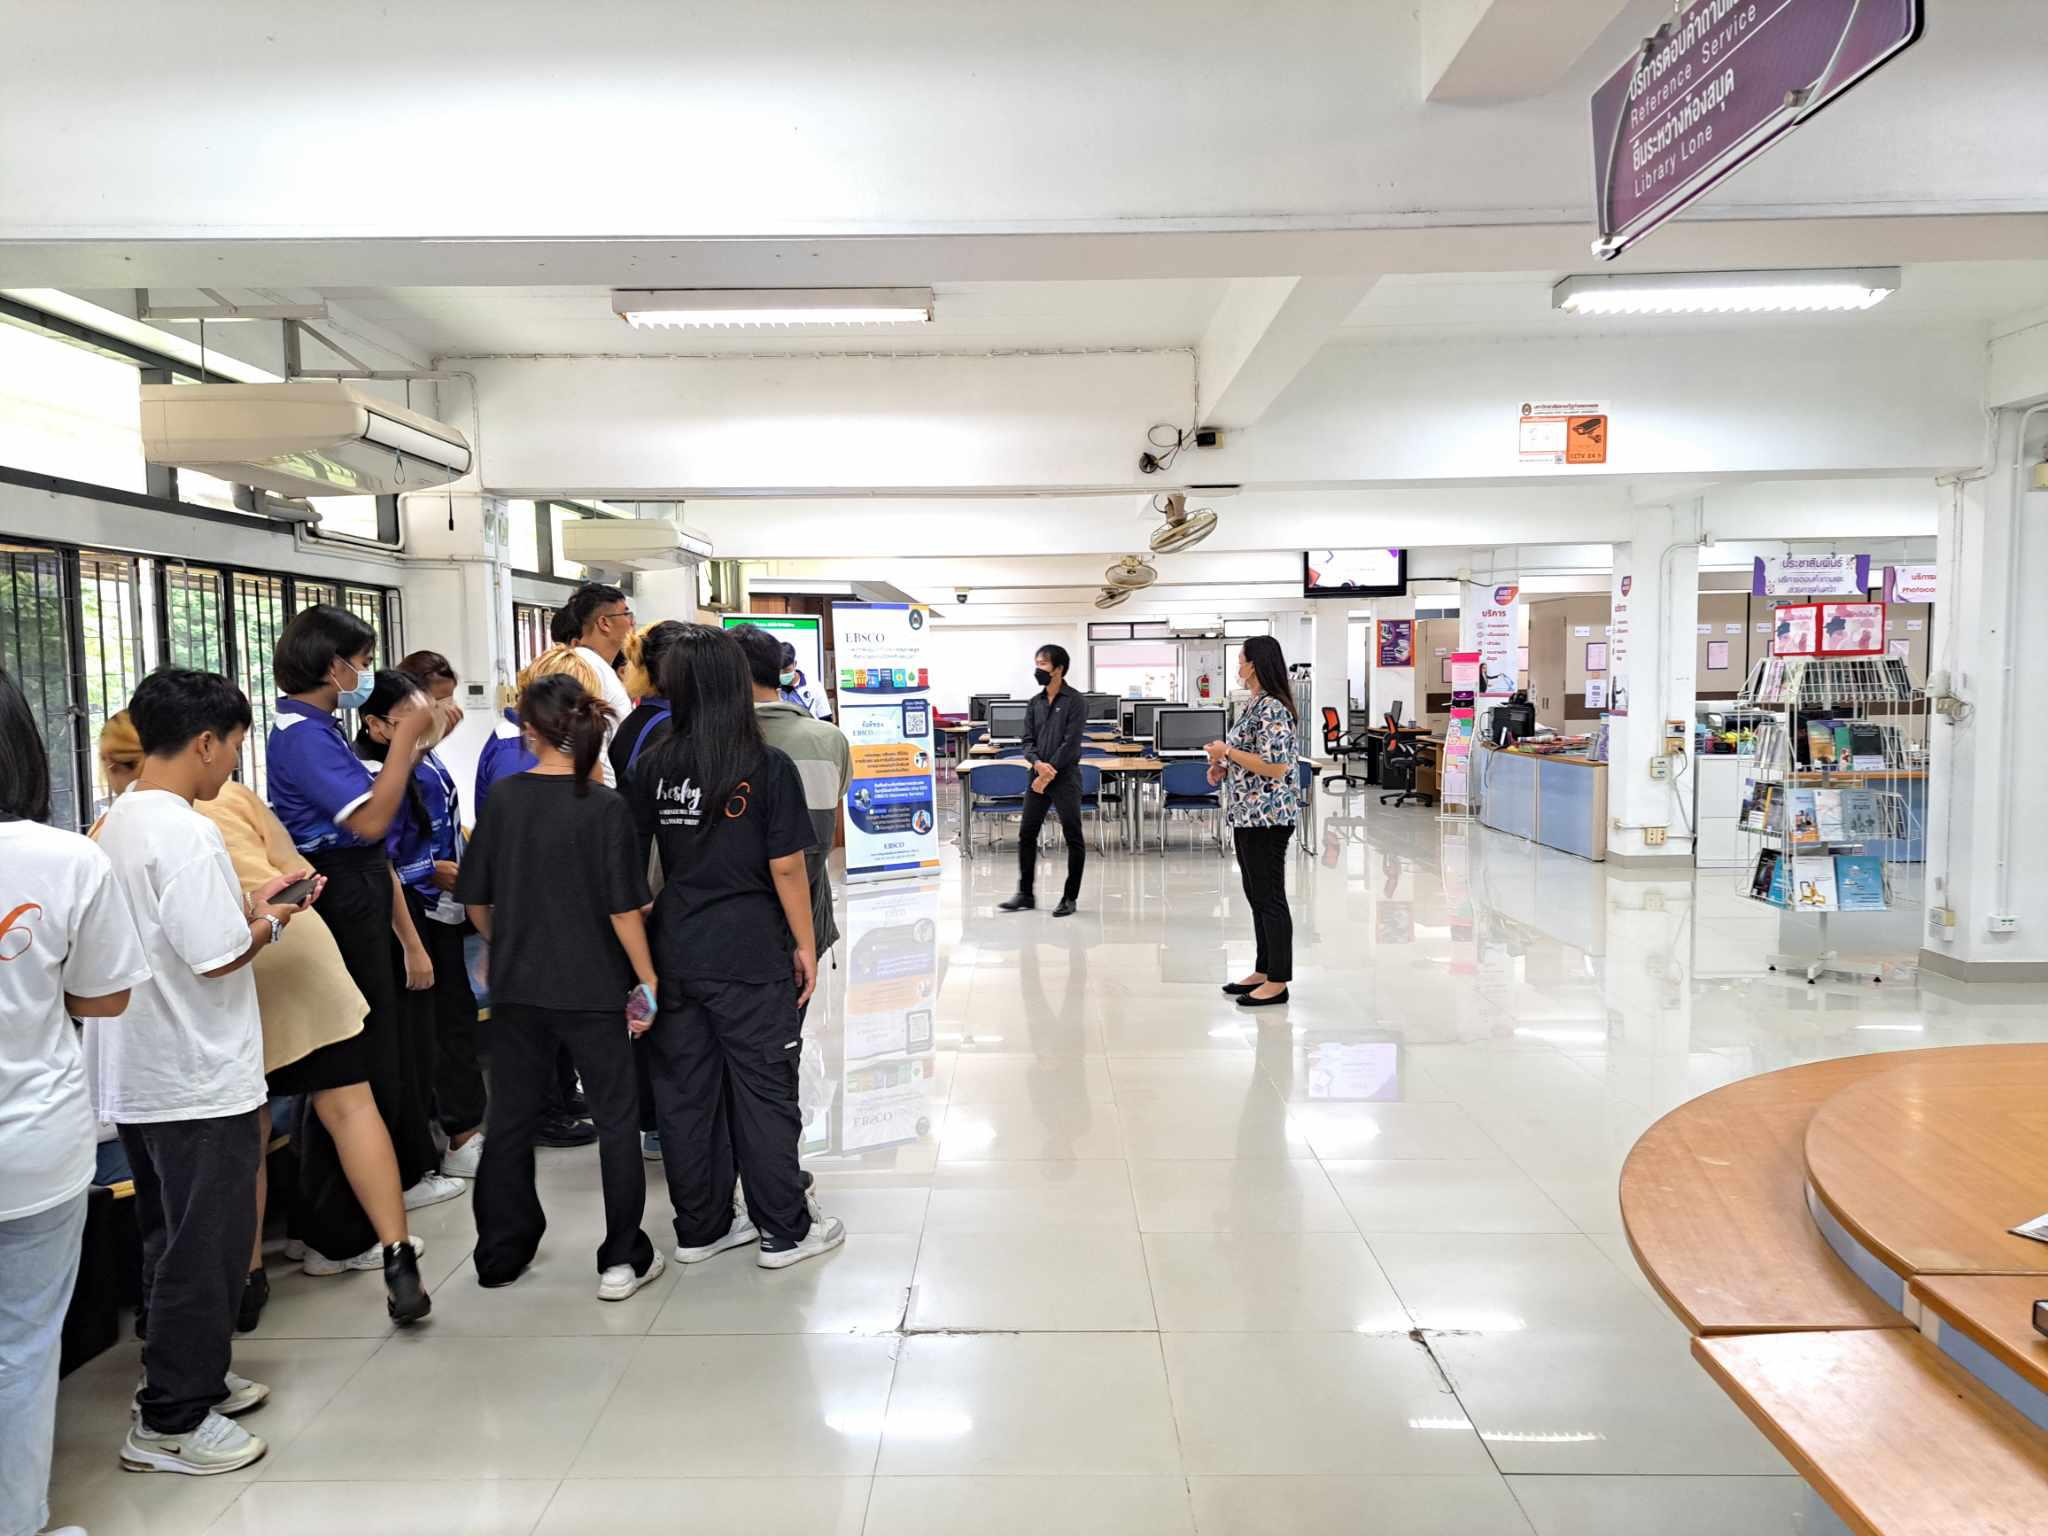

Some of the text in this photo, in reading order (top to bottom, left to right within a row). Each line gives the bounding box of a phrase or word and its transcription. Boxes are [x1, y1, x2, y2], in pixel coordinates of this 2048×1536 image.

[1630, 4, 1757, 129] Reference Service
[1632, 68, 1735, 171] ยืมระหว่างห้องสมุด
[1634, 124, 1713, 198] Library Lone
[845, 632, 886, 643] EBSCO
[1482, 608, 1507, 617] บริการ
